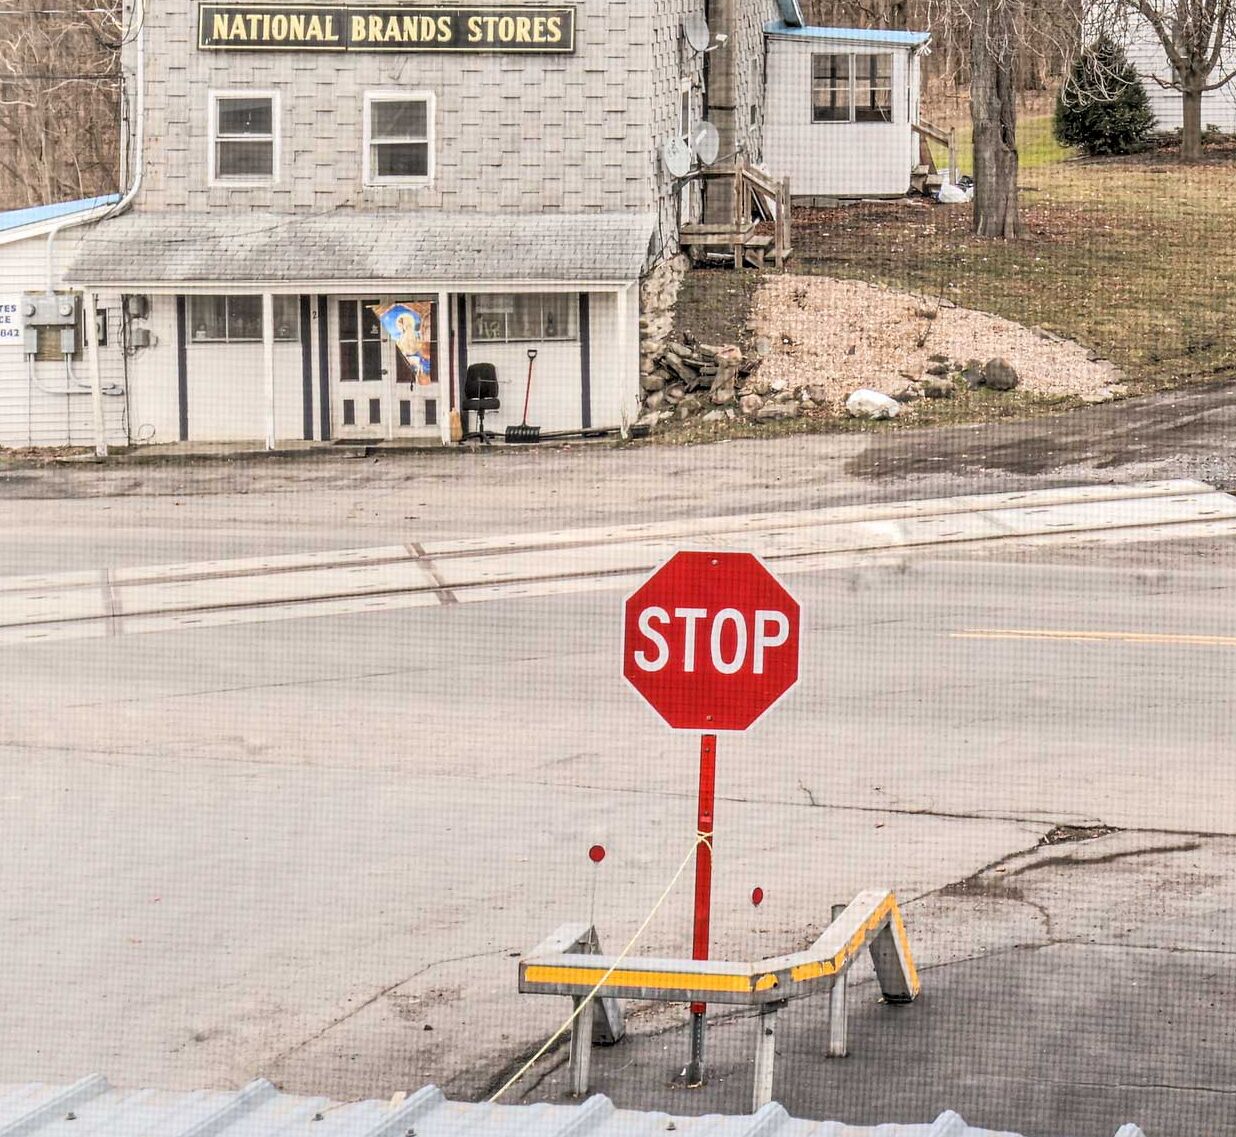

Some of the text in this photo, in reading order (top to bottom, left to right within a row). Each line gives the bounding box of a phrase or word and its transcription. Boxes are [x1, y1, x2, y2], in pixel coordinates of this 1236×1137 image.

[213, 14, 562, 43] NATIONAL BRANDS STORES
[634, 606, 790, 675] STOP
